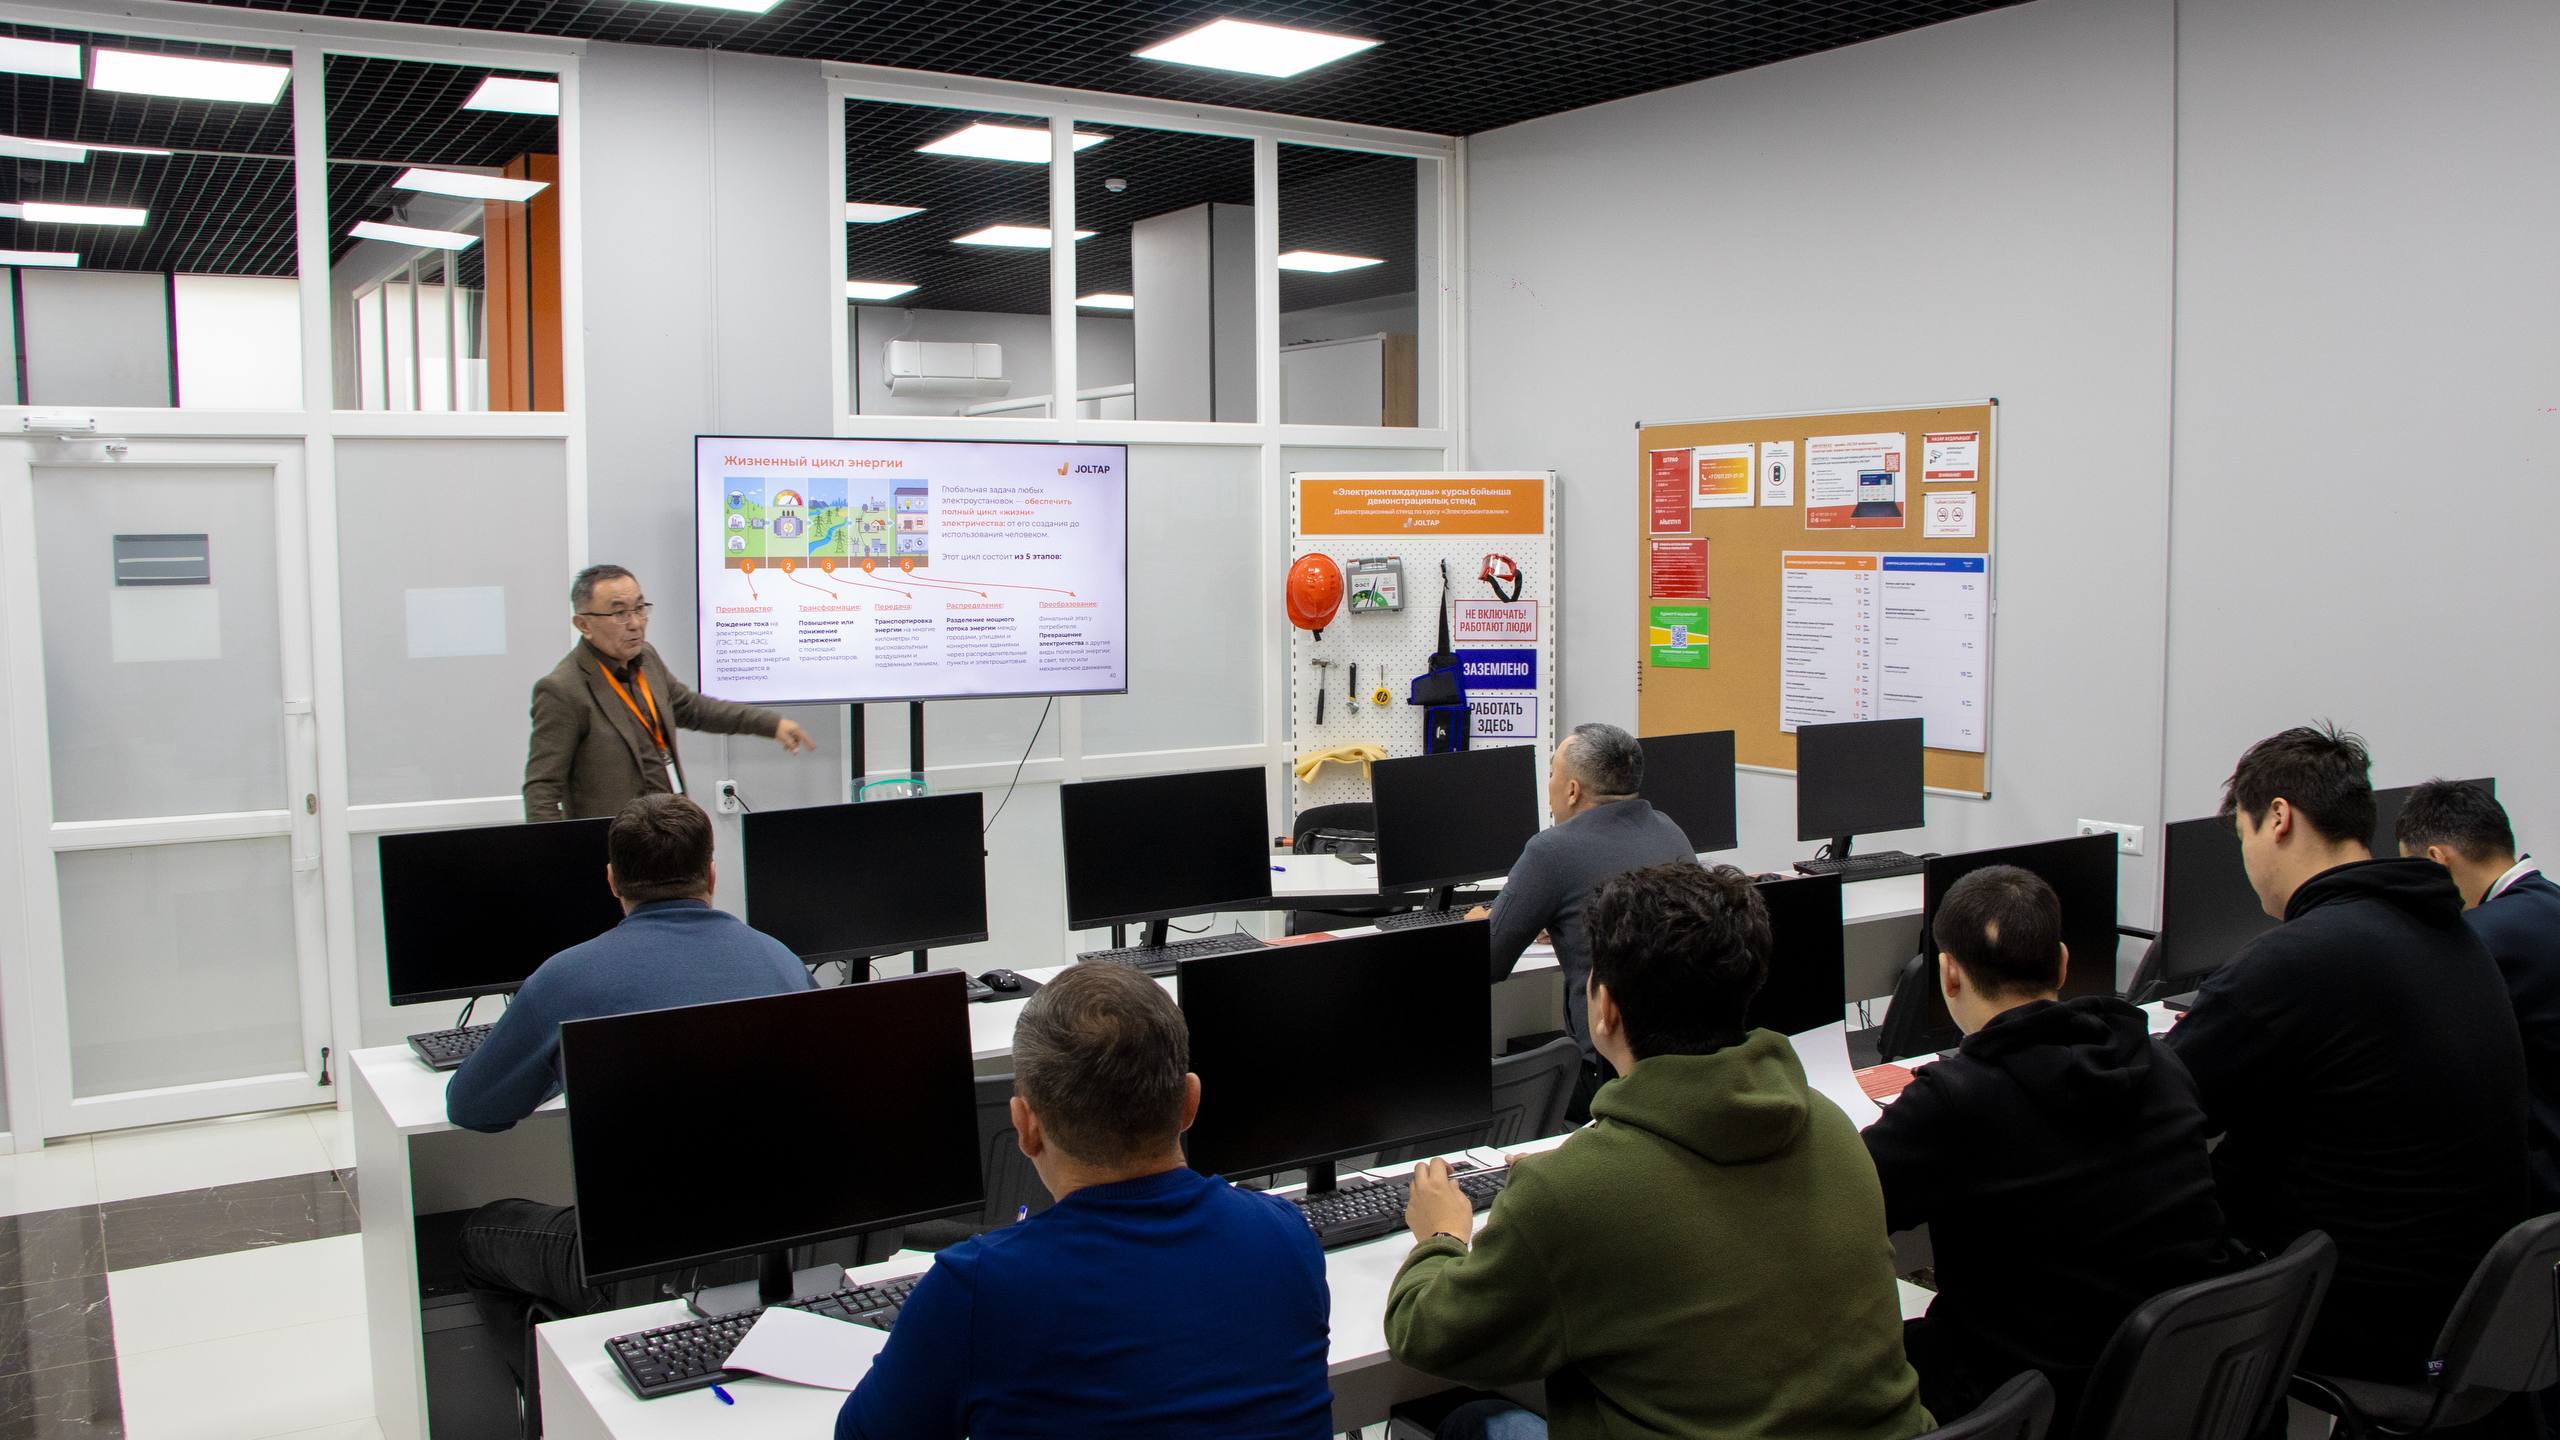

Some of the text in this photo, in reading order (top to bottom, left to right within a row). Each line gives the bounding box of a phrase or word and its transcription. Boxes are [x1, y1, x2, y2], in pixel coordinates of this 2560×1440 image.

[724, 456, 903, 470] Жизненный цикл энергии
[1075, 465, 1111, 474] JOLTAP
[942, 485, 987, 494] Глобальная
[989, 487, 1016, 495] задача
[1441, 489, 1469, 497] курсы
[1470, 487, 1512, 496] бойынша
[942, 498, 1013, 507] электроустановок
[1024, 497, 1072, 505] обеспечить
[1367, 497, 1477, 506] демонстрациялық стенд
[942, 508, 975, 516] полный
[976, 509, 997, 517] цикл
[942, 520, 1006, 528] электричества:
[1069, 521, 1080, 529] до
[942, 531, 1003, 539] использования
[961, 554, 981, 562] цикл
[1032, 553, 1062, 561] этапов:
[785, 563, 791, 571] 2
[825, 563, 832, 571] 3
[866, 563, 872, 571] 4
[904, 563, 910, 571] 5
[1465, 609, 1527, 619] НЕ ВКЛЮЧАТЬ!
[798, 619, 840, 627] Повышение
[875, 618, 933, 626] Транспортировка
[986, 616, 1015, 624] мощного
[1460, 622, 1532, 633] РАБОТАЮТ ЛЮДИ
[1463, 662, 1529, 676] ЗАЗЕМЛЕНО
[1469, 702, 1523, 715] РАБОТАТЬ
[1478, 719, 1514, 734] ЗДЕСЬ
